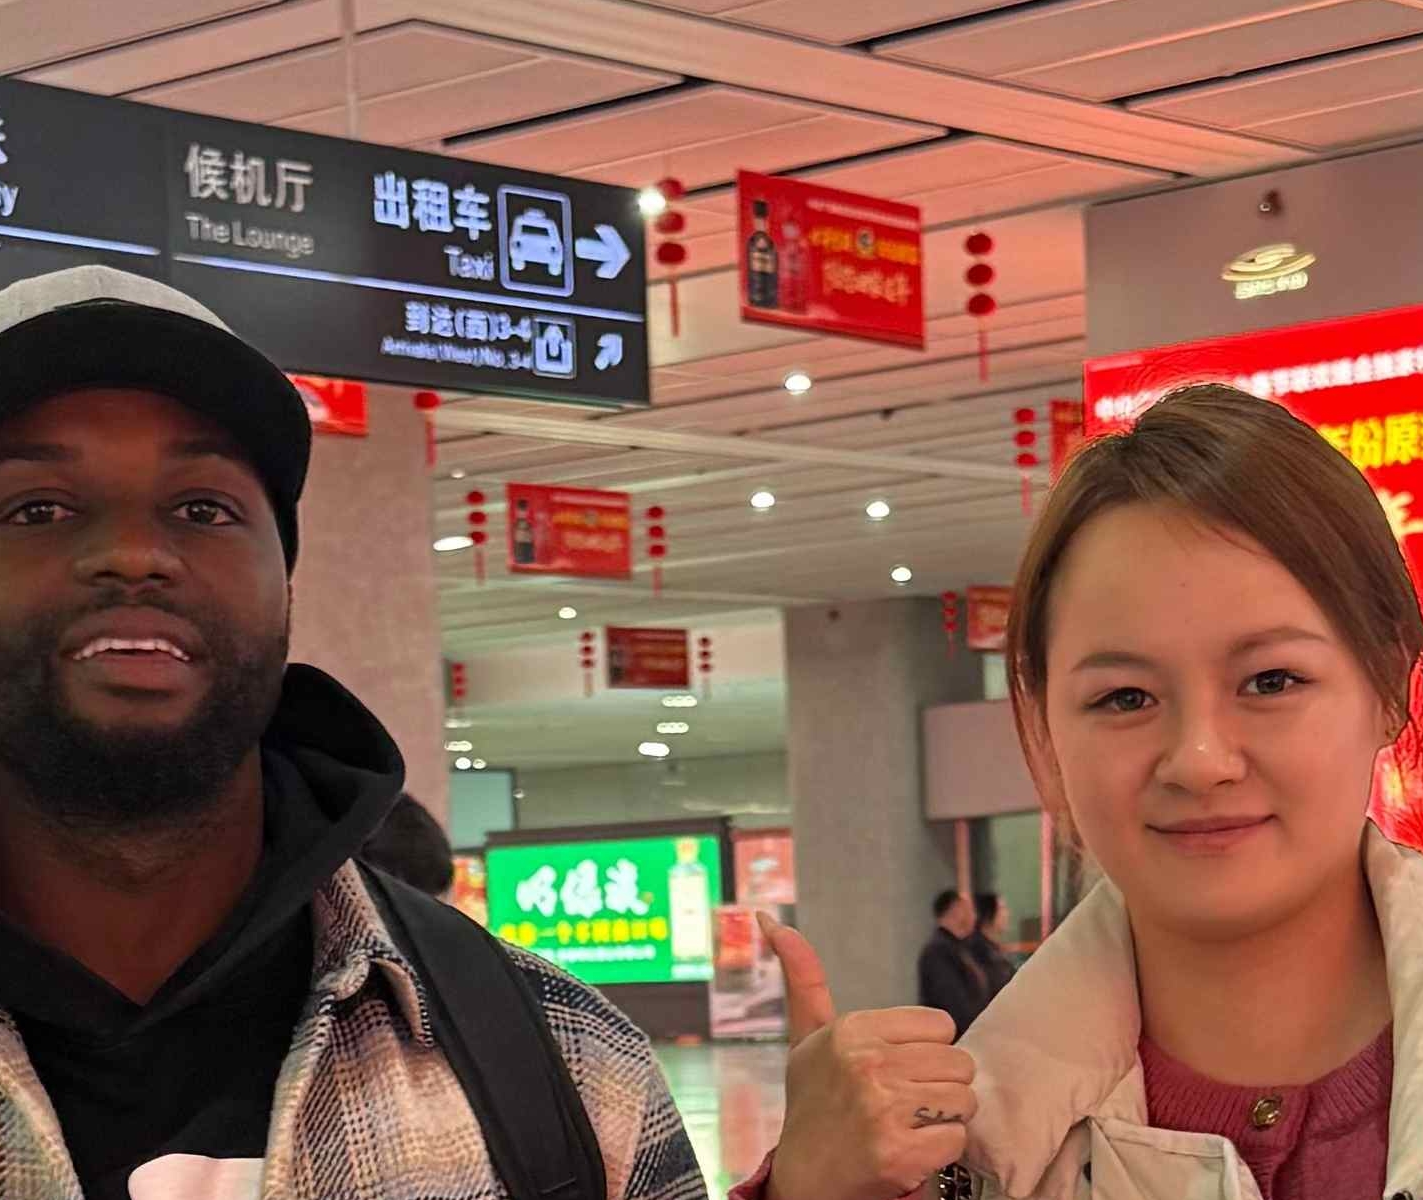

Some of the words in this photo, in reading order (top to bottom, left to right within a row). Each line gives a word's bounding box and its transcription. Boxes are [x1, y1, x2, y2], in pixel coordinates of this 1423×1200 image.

[183, 142, 313, 213] 候机厅
[373, 170, 492, 241] 出租车
[183, 212, 231, 244] The
[233, 220, 314, 259] Lounge
[443, 245, 495, 281] Taxi
